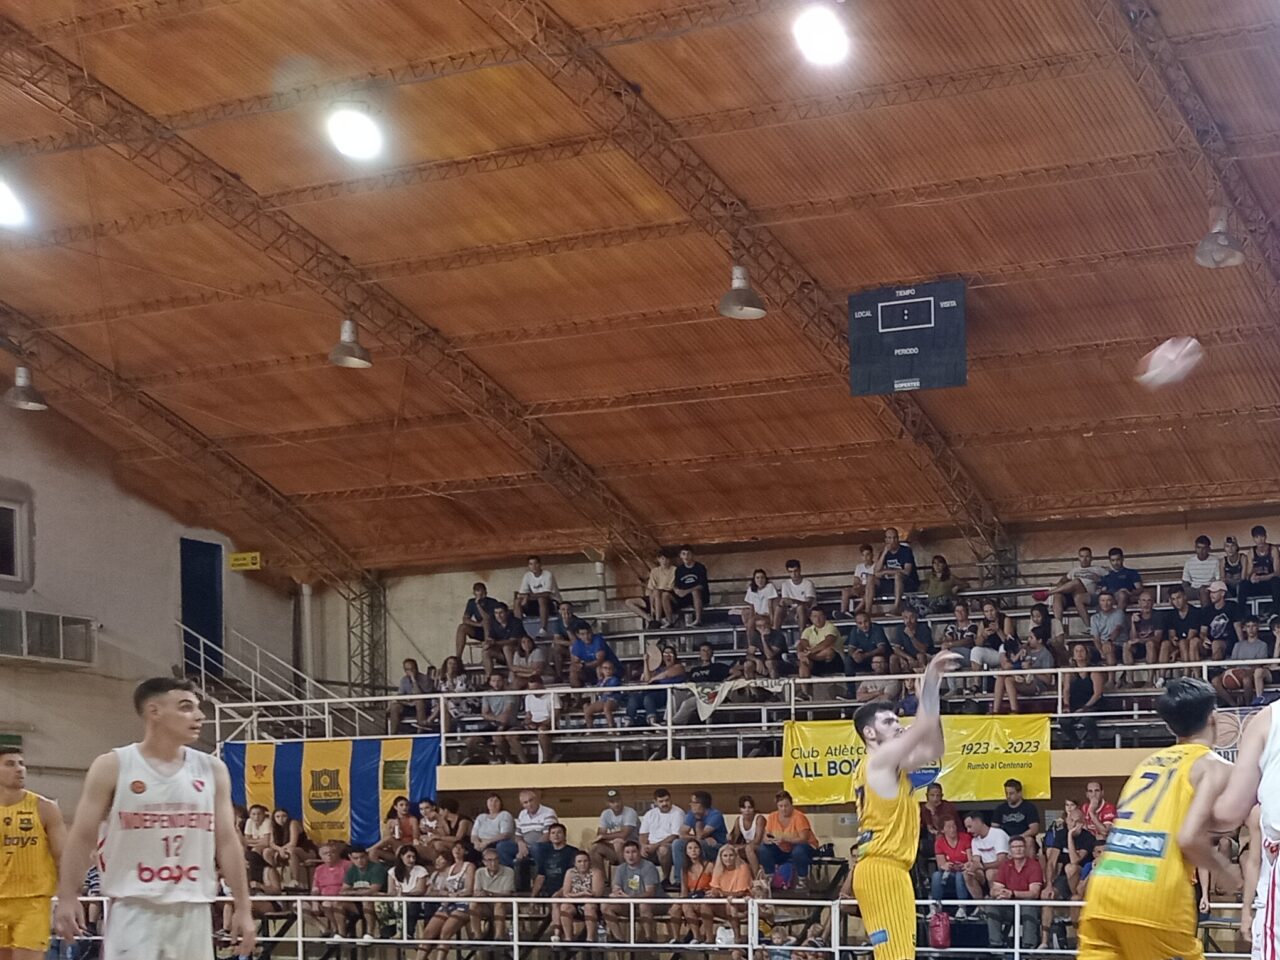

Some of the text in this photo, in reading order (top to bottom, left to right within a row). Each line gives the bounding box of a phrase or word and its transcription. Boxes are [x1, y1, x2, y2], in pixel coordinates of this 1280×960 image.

[895, 288, 916, 297] TIEMPO
[854, 310, 872, 318] LOCAL
[790, 747, 820, 760] Club
[961, 742, 989, 755] 1923
[1004, 740, 1040, 753] 2023
[792, 762, 823, 778] ALL
[967, 761, 1033, 770] Rumbo al Centenario
[4, 834, 38, 848] boys
[161, 834, 184, 858] 12
